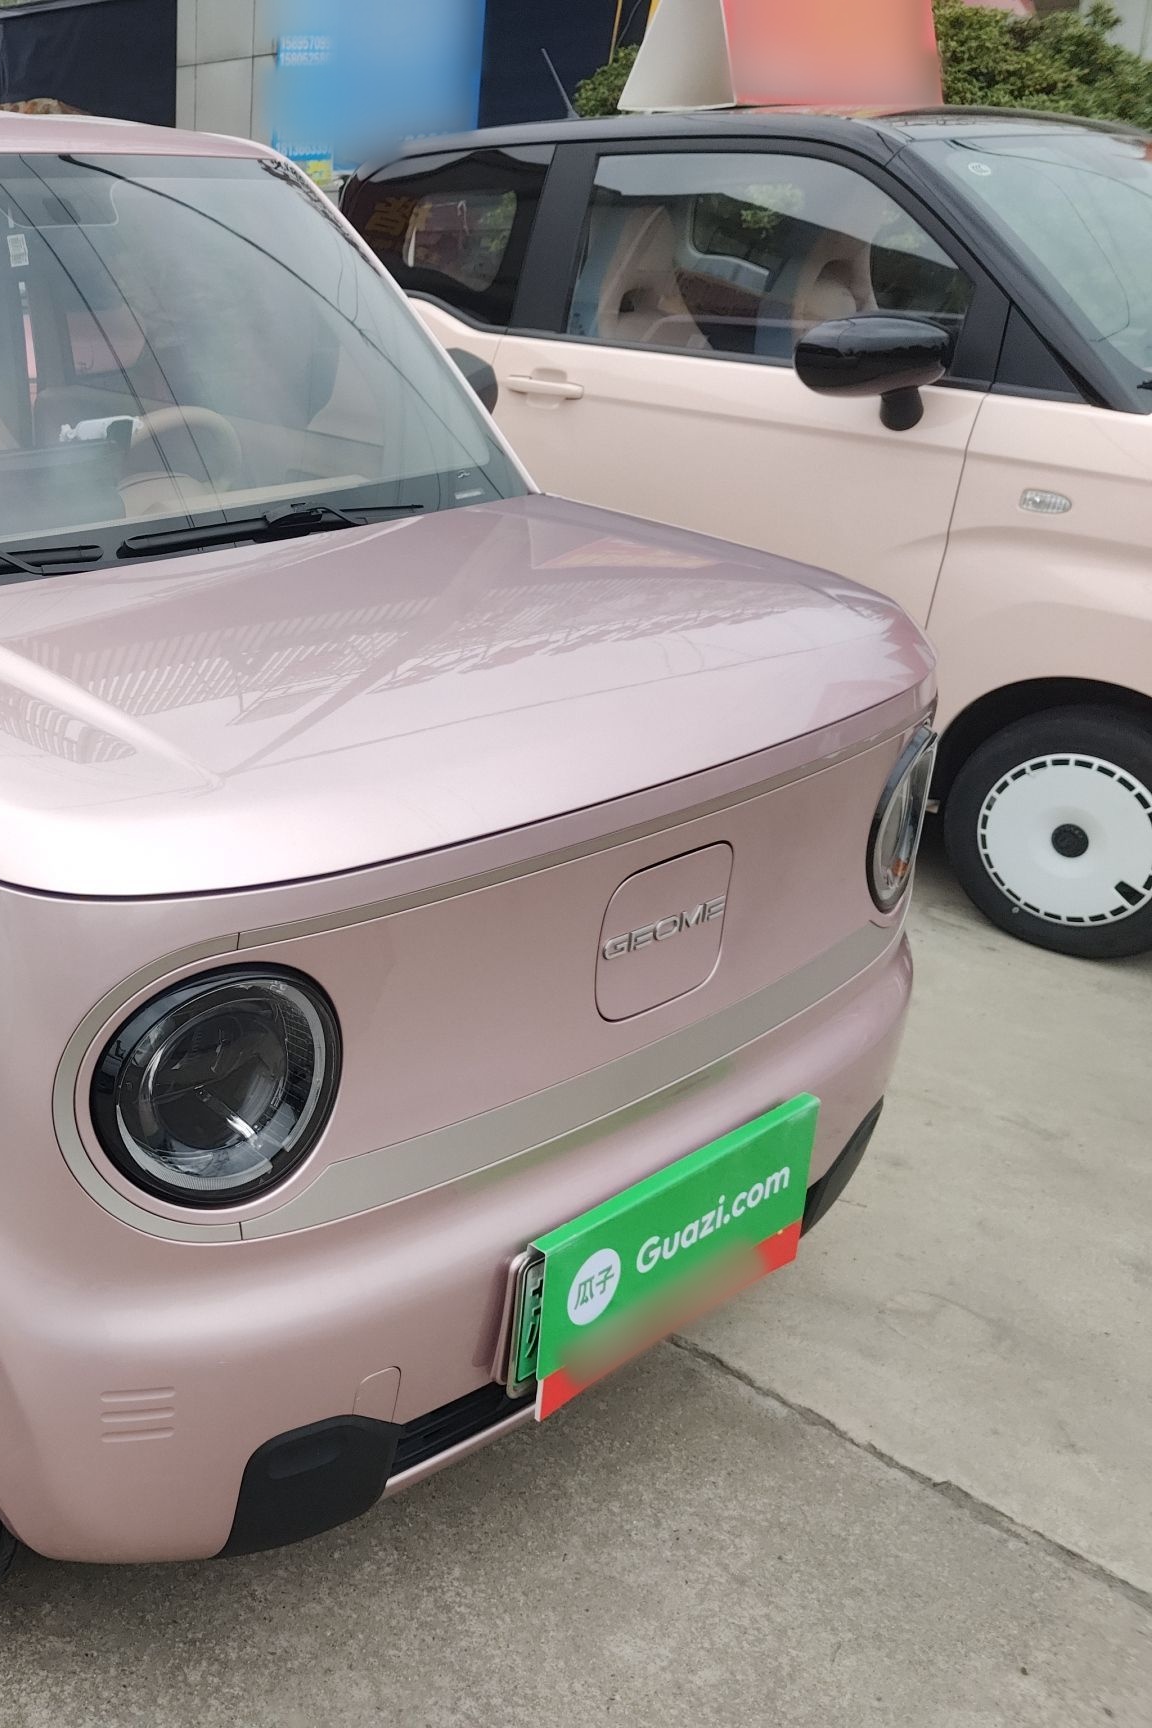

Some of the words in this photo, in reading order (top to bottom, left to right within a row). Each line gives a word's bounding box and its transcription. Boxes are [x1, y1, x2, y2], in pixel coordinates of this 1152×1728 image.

[602, 895, 726, 960] GEOME
[635, 1166, 791, 1274] Guazi.com
[573, 1263, 615, 1311] 瓜子
